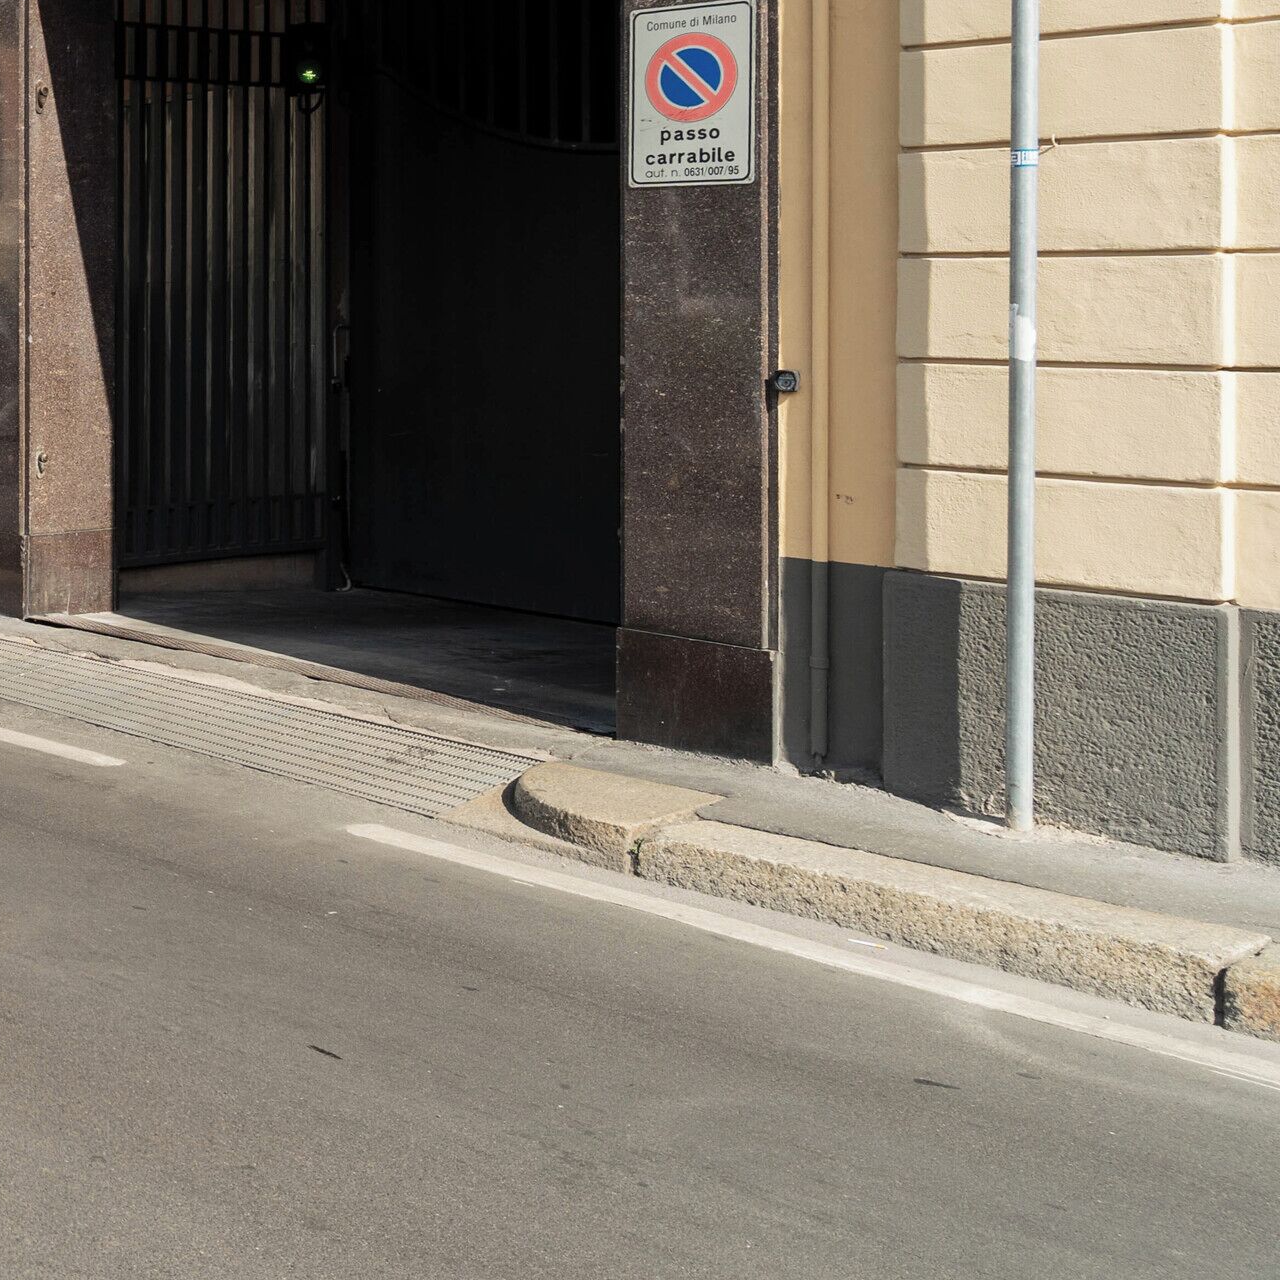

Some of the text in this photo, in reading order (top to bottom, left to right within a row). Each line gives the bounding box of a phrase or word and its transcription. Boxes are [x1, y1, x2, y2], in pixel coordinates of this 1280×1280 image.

[646, 14, 737, 32] Comune di Milano
[660, 127, 720, 145] passo
[645, 147, 735, 166] carrabile
[645, 165, 739, 178] aut. n. 0631/007/95
